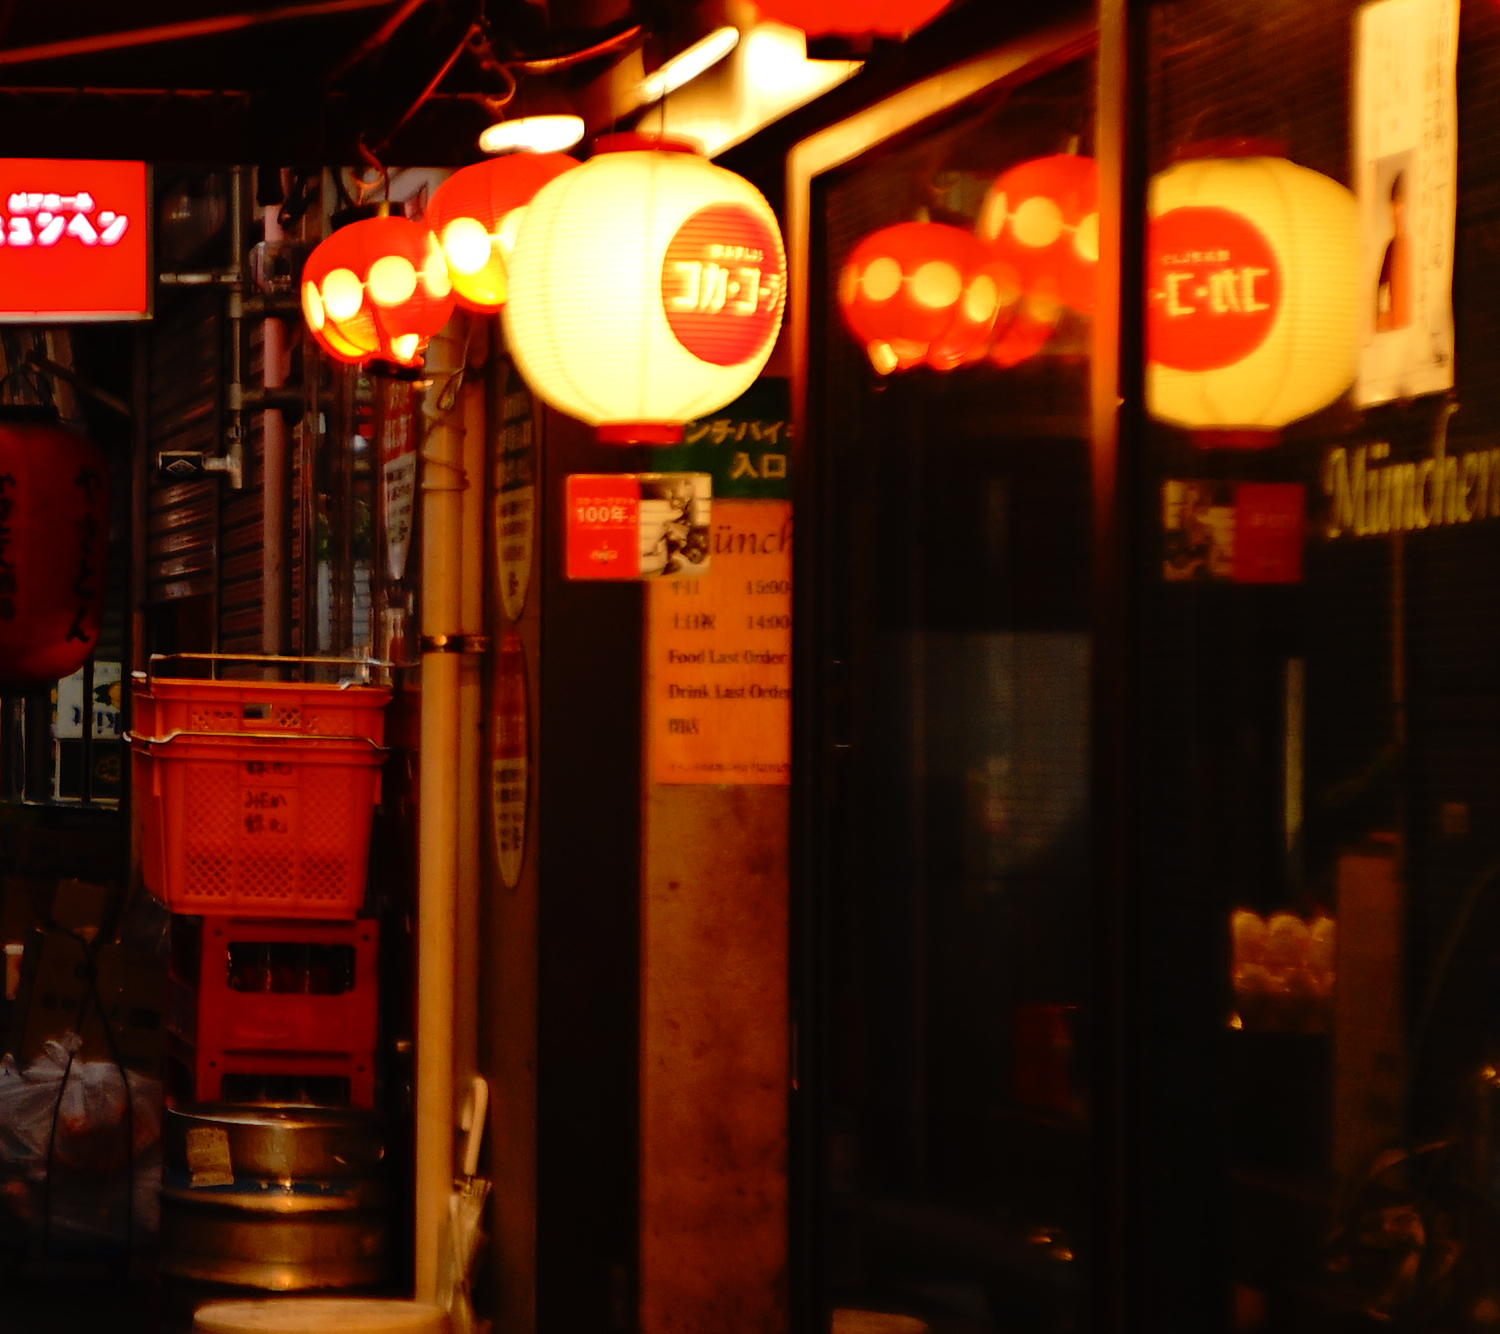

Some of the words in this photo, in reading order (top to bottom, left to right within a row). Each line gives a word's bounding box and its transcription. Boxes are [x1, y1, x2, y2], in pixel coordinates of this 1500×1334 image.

[671, 260, 782, 316] コカ・コーラ
[731, 451, 787, 479] 入口
[66, 467, 99, 643] やきとん
[668, 649, 706, 664] Food
[708, 649, 740, 664] Last
[743, 649, 788, 664] Order
[668, 683, 711, 699] Drink
[713, 683, 746, 699] Last
